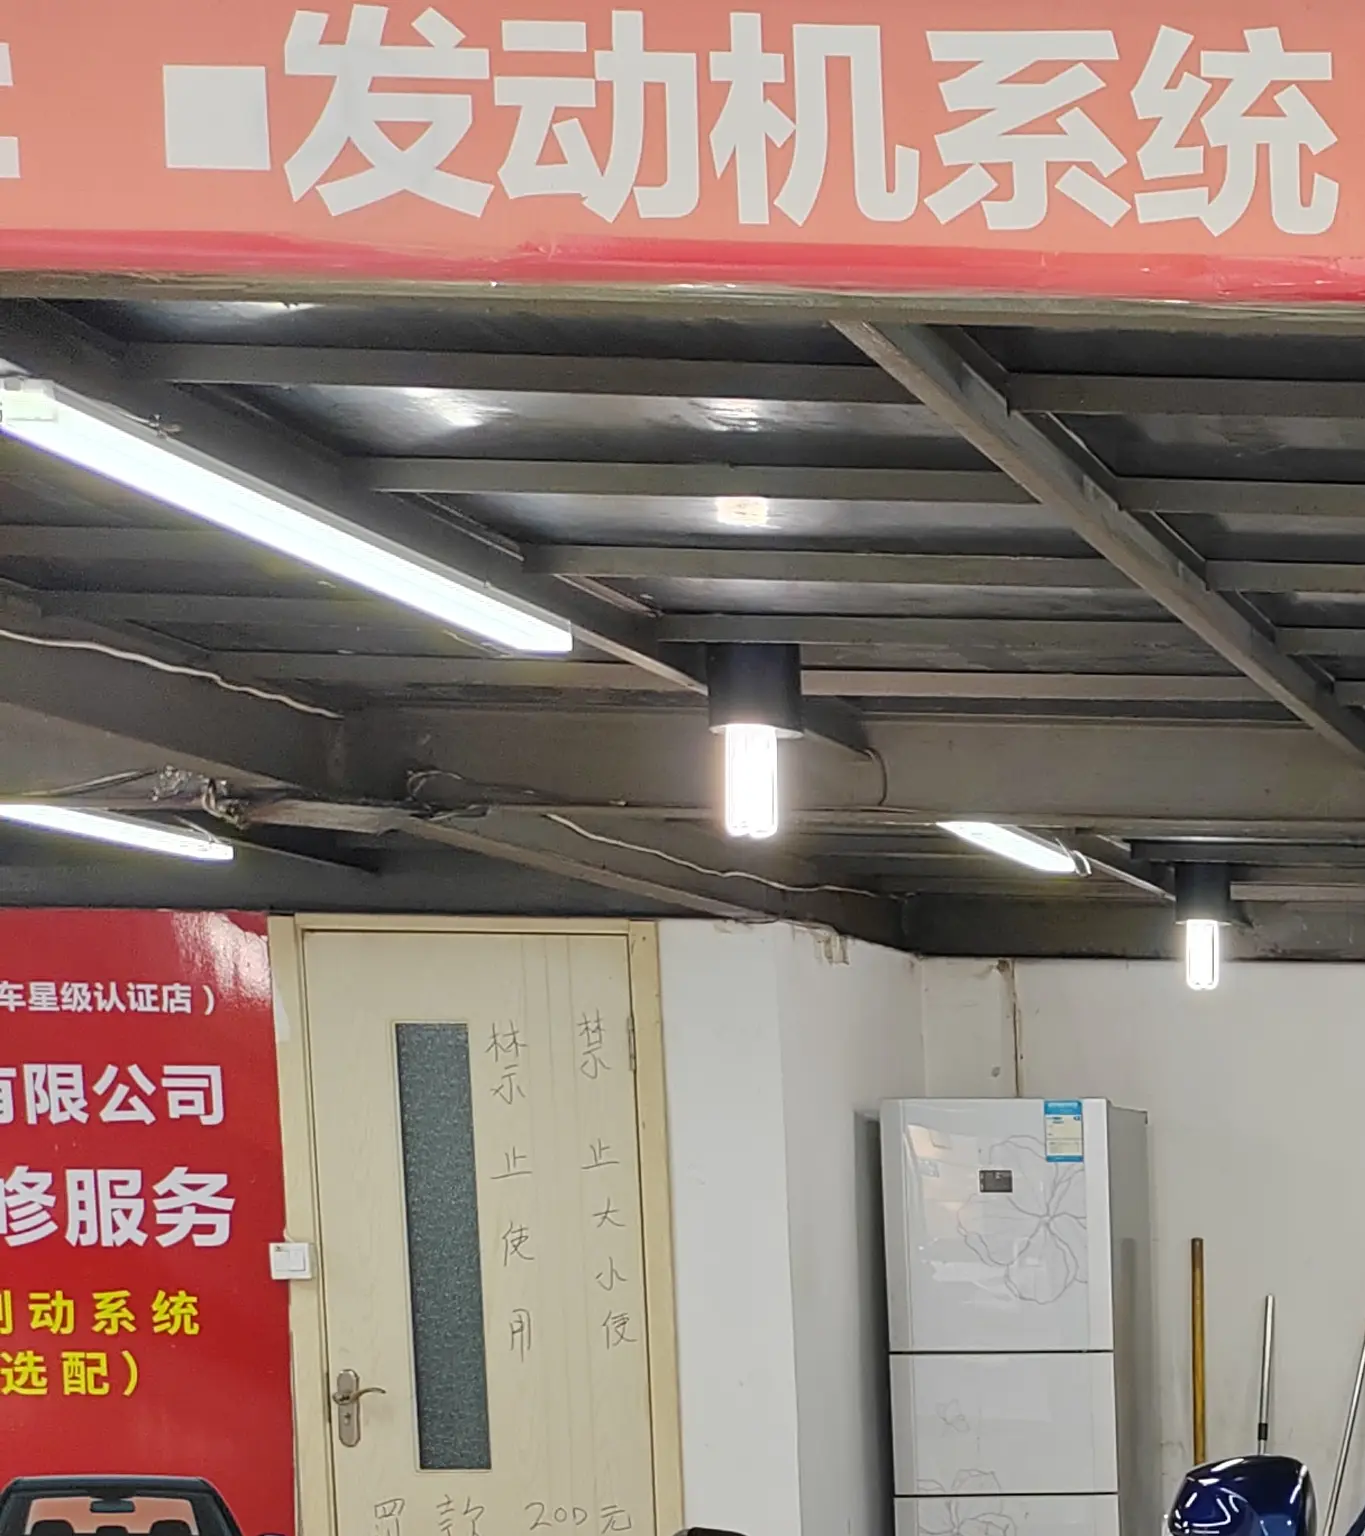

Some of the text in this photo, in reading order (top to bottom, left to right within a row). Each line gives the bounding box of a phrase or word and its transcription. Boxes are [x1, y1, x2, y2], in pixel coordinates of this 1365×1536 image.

[284, 3, 1340, 237] 发动机系统
[0, 1064, 224, 1126] 限公司
[0, 1290, 200, 1335] 动系统
